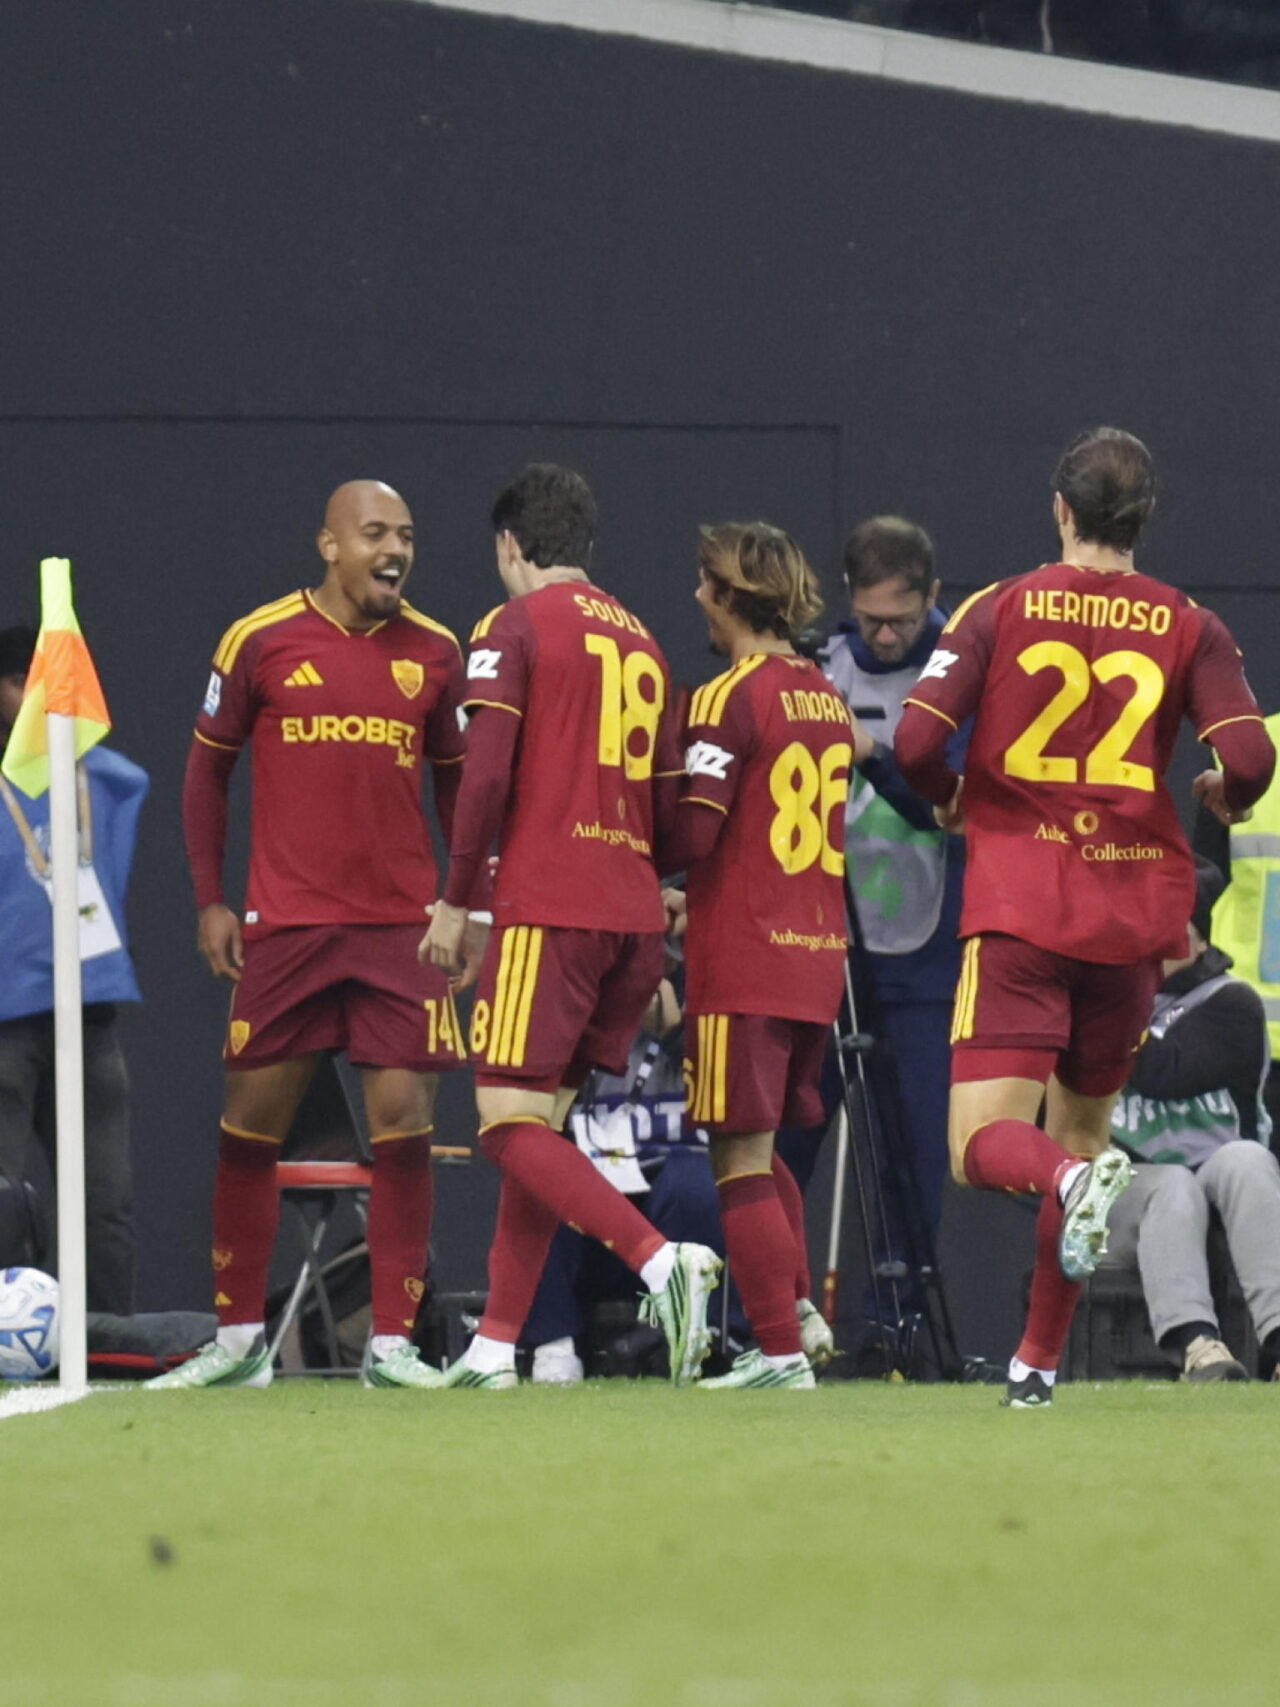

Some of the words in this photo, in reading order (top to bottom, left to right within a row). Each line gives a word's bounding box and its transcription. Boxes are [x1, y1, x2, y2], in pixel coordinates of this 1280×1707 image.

[1025, 589, 1172, 636] HERMOSO
[281, 715, 416, 750] EUROBET
[584, 632, 666, 781] 18
[1004, 640, 1165, 793] 22
[769, 741, 853, 877] 86
[1081, 842, 1163, 861] Collection
[424, 996, 454, 1054] 14
[470, 999, 490, 1054] 8
